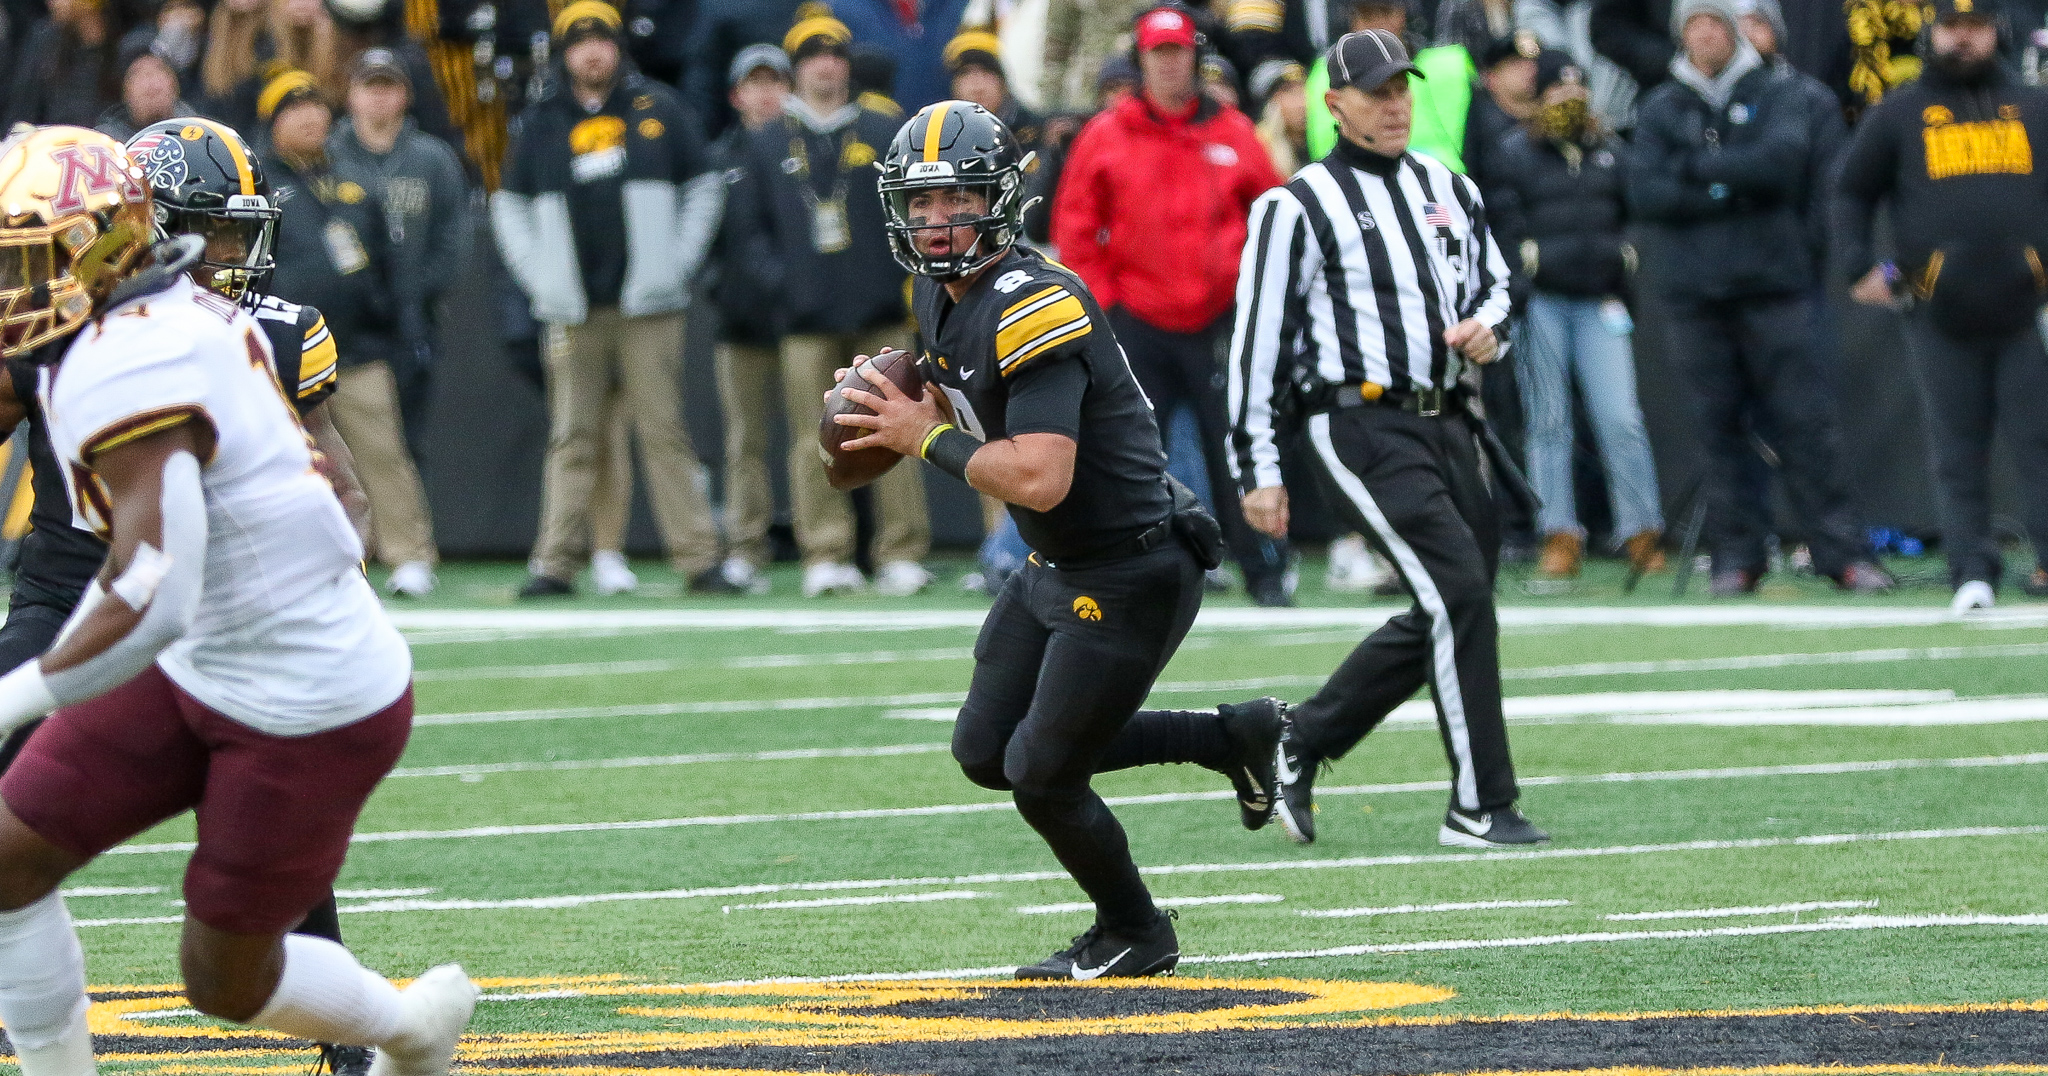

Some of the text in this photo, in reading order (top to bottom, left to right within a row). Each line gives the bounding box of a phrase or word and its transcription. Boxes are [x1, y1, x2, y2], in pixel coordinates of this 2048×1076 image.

[919, 164, 940, 173] IOWA
[242, 198, 260, 207] IOWA
[1357, 211, 1376, 230] S
[994, 269, 1035, 294] 8
